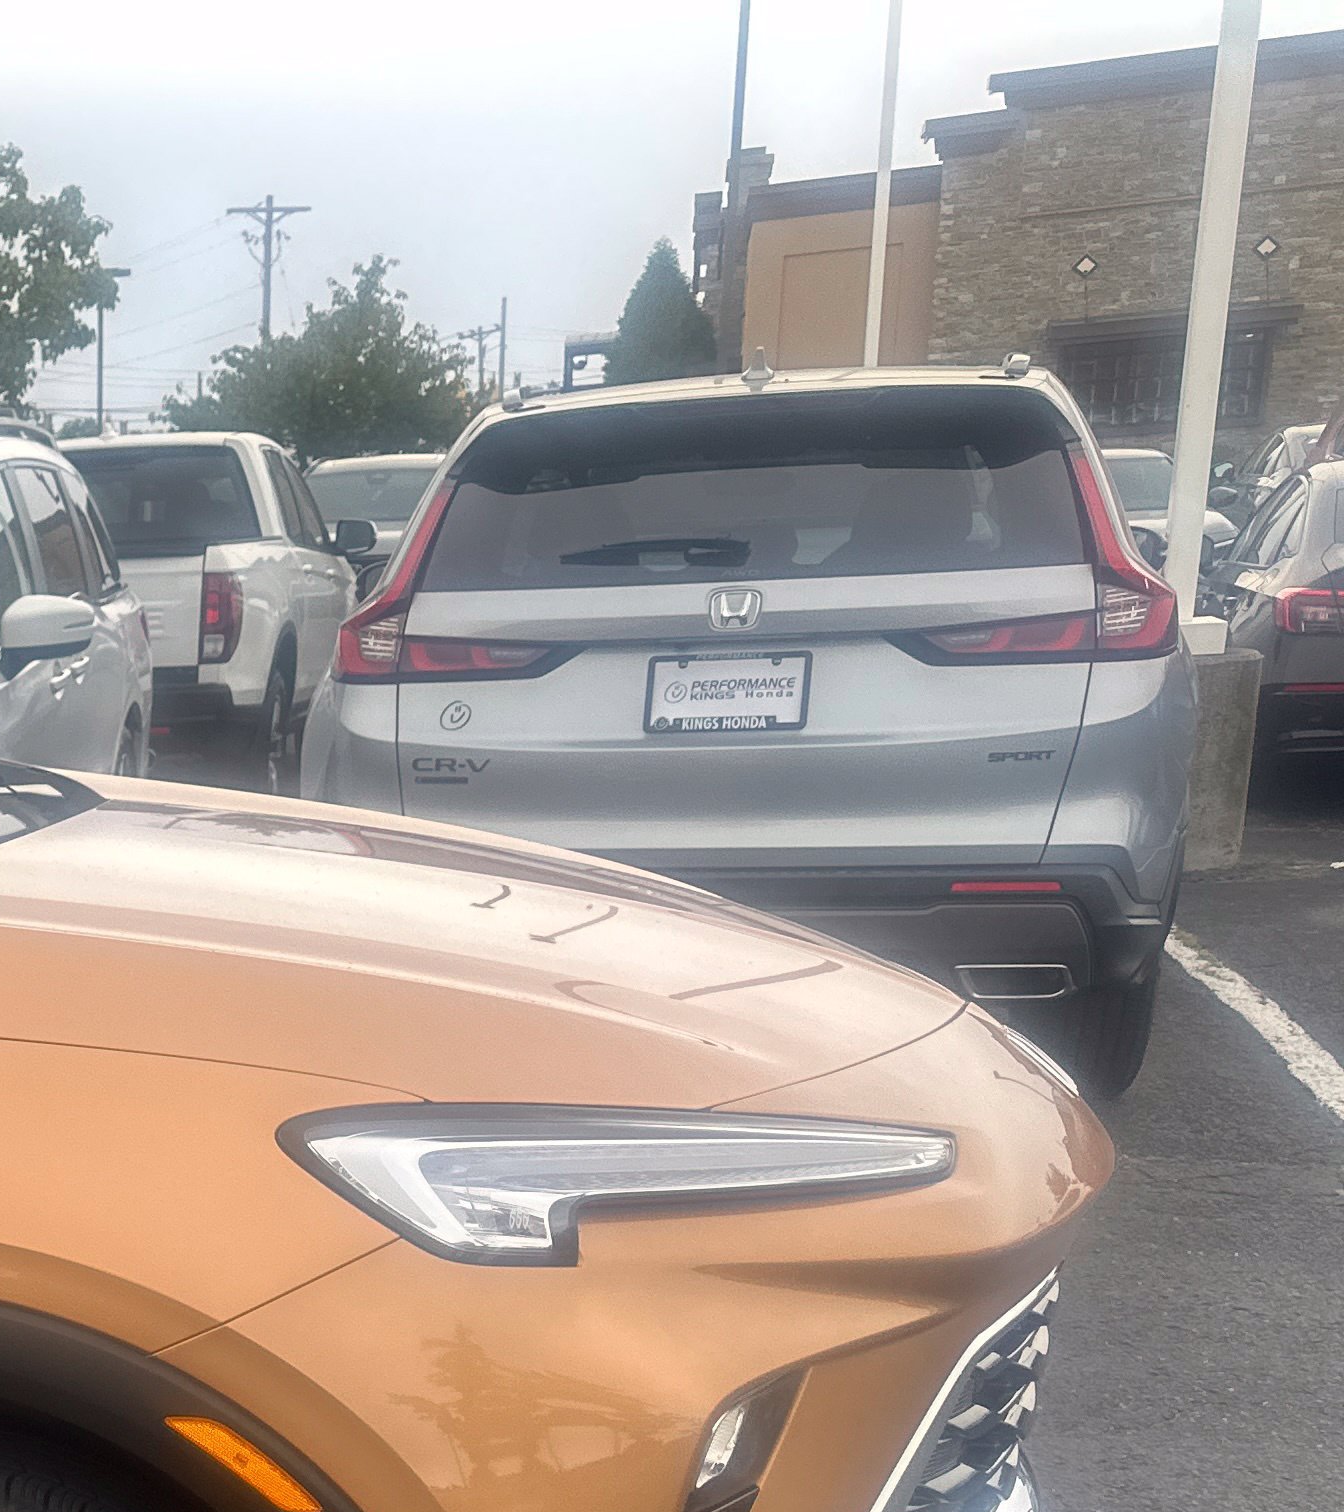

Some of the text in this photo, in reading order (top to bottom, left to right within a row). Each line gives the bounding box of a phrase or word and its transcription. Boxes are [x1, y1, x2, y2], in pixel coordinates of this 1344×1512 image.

[691, 676, 797, 691] PERFORMANCE
[690, 688, 794, 701] KINGS Honda
[681, 715, 767, 731] KINGS HONDA
[987, 749, 1057, 763] SPORT
[412, 758, 490, 773] CR-V
